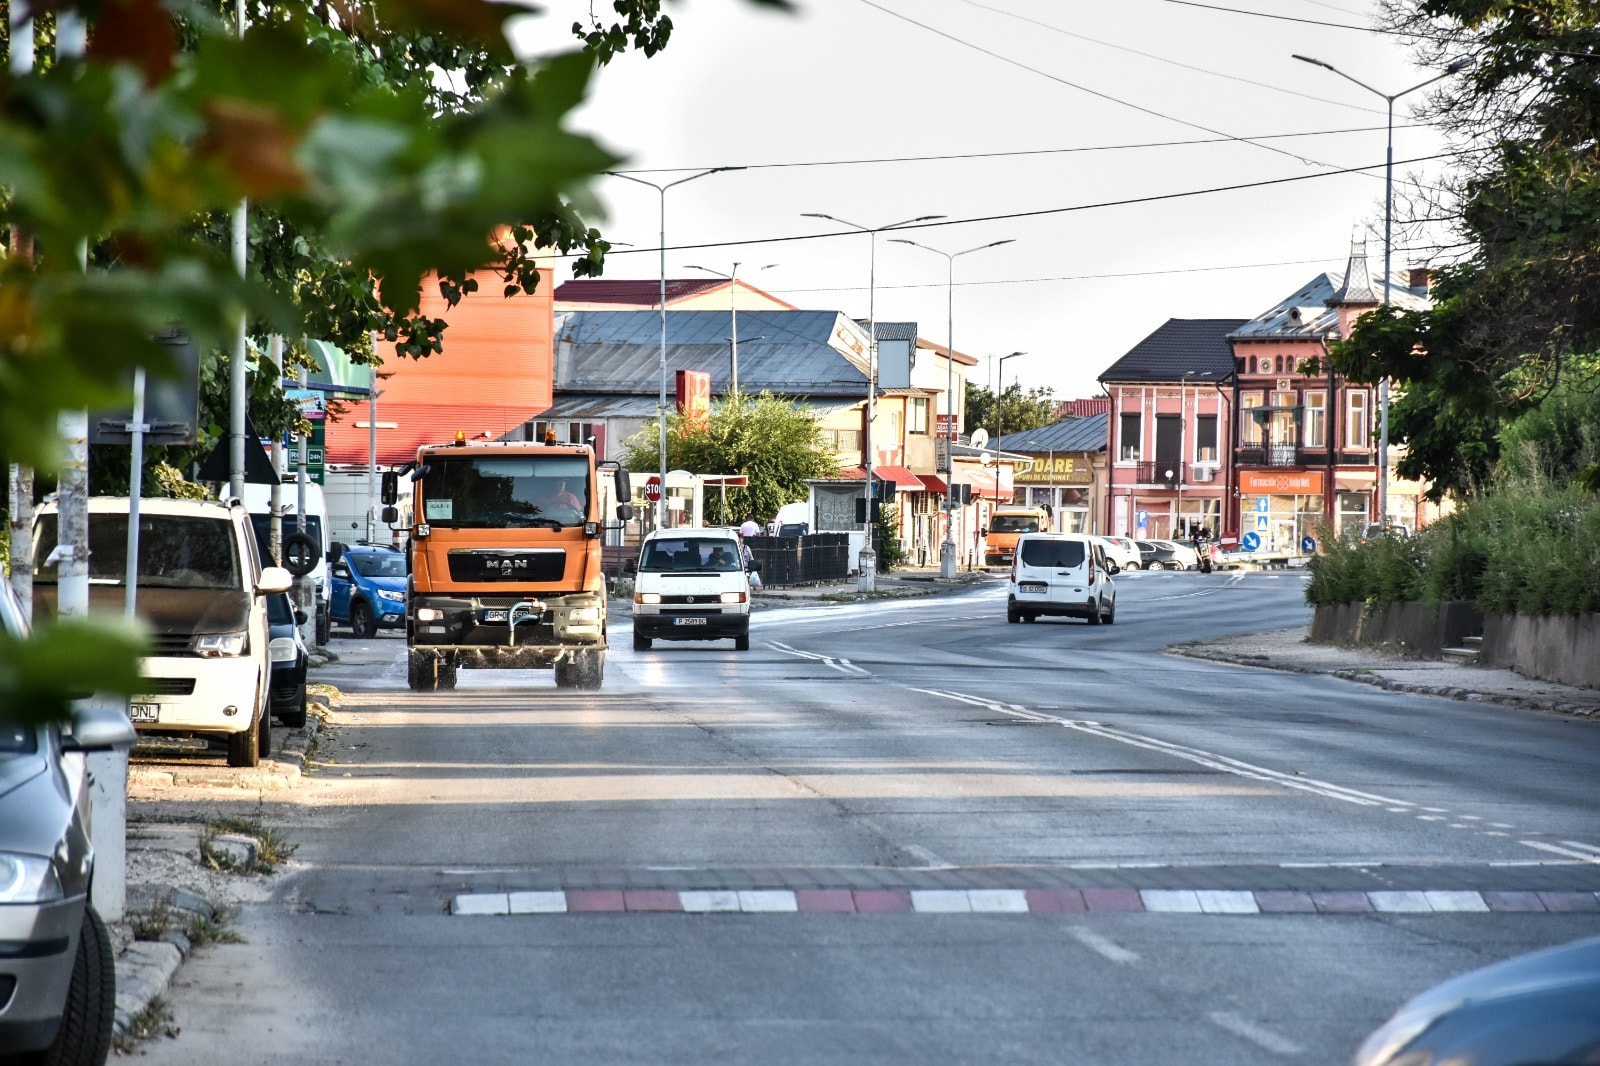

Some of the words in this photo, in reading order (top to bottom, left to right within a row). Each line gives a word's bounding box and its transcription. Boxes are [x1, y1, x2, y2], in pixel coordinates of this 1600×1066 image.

[646, 484, 661, 494] STO
[486, 559, 528, 569] MAN
[131, 705, 156, 718] DNL
